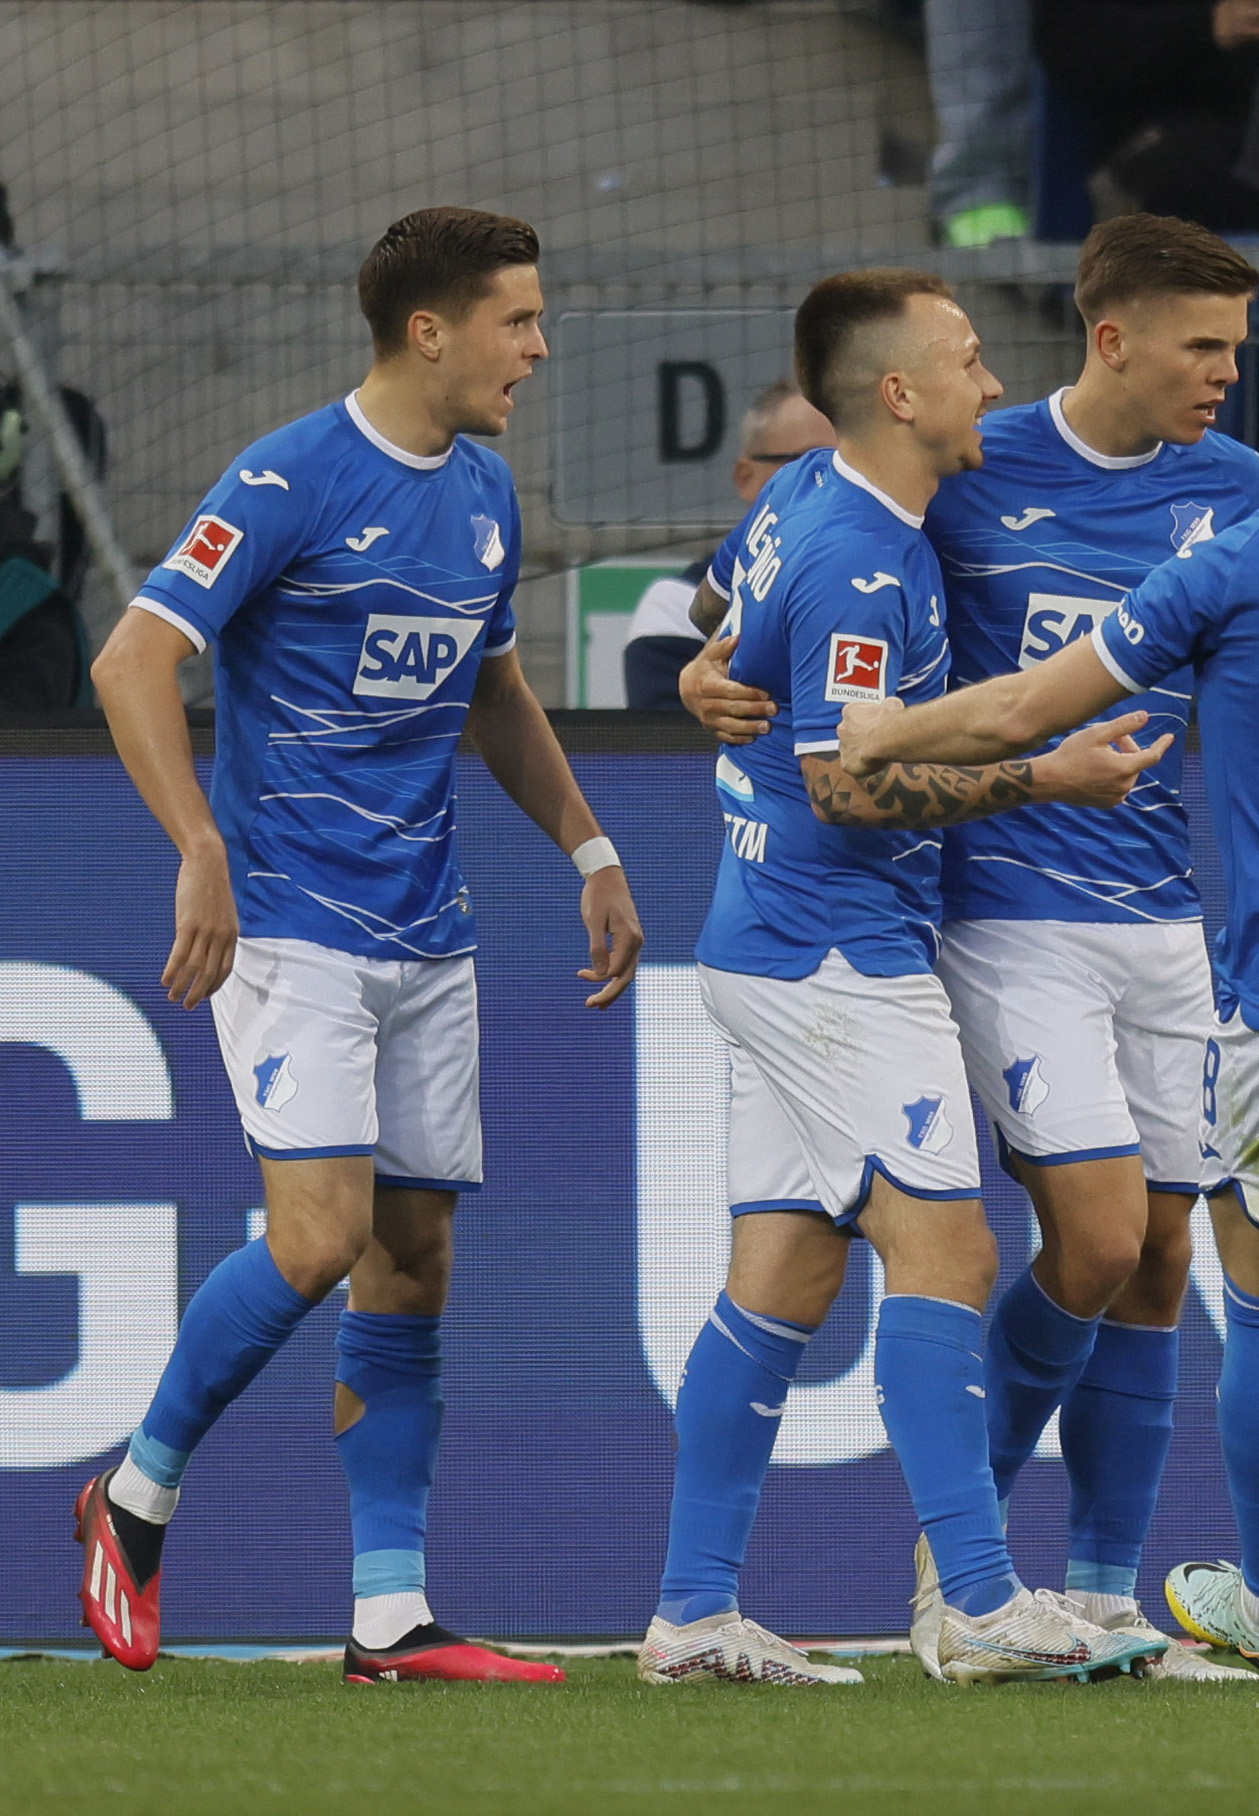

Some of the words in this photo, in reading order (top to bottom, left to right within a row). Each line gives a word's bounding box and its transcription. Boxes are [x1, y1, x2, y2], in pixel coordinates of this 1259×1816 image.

[657, 360, 726, 462] D
[360, 629, 458, 685] SAP
[831, 688, 880, 701] BUNDESLIGA
[1203, 1037, 1221, 1127] 8
